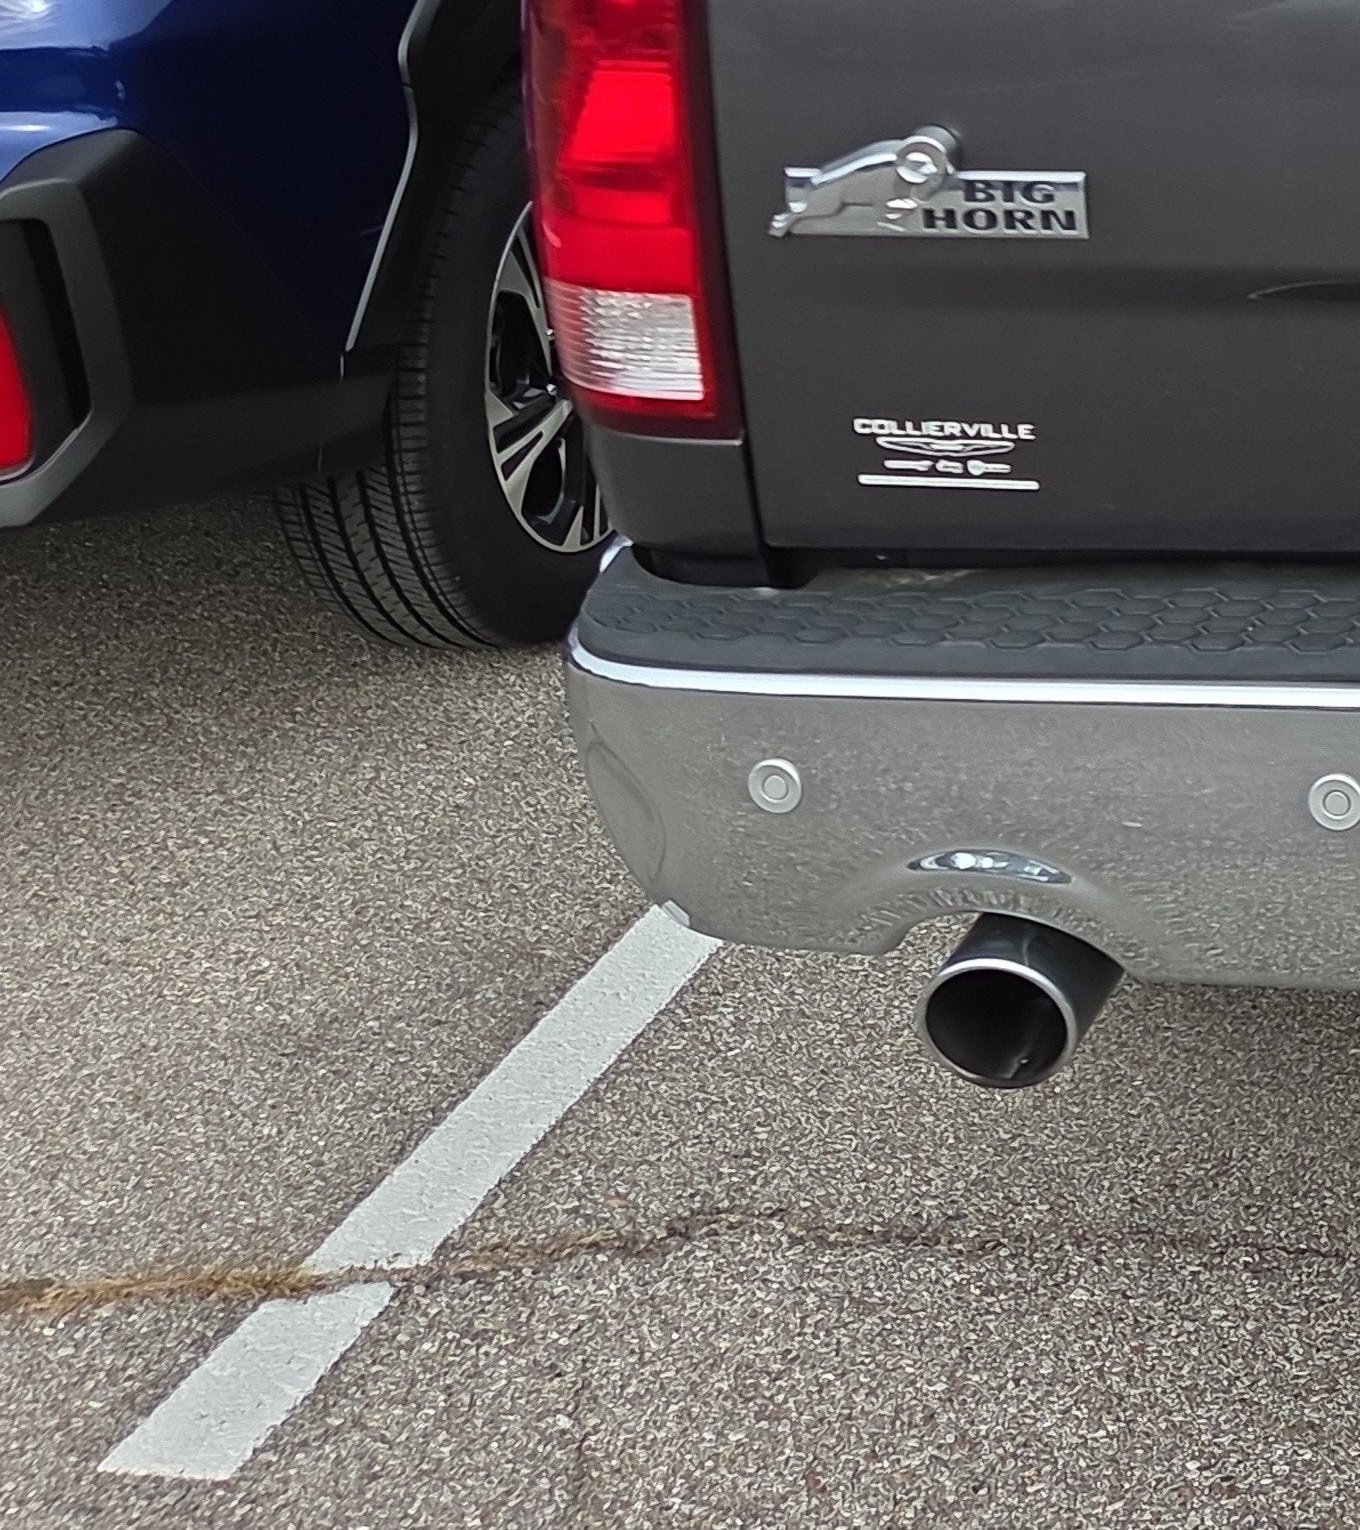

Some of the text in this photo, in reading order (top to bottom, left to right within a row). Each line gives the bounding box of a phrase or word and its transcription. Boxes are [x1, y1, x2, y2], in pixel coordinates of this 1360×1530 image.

[963, 179, 1056, 204] BIG
[922, 207, 1077, 231] HORN
[853, 418, 1037, 440] COLLIERVILLE
